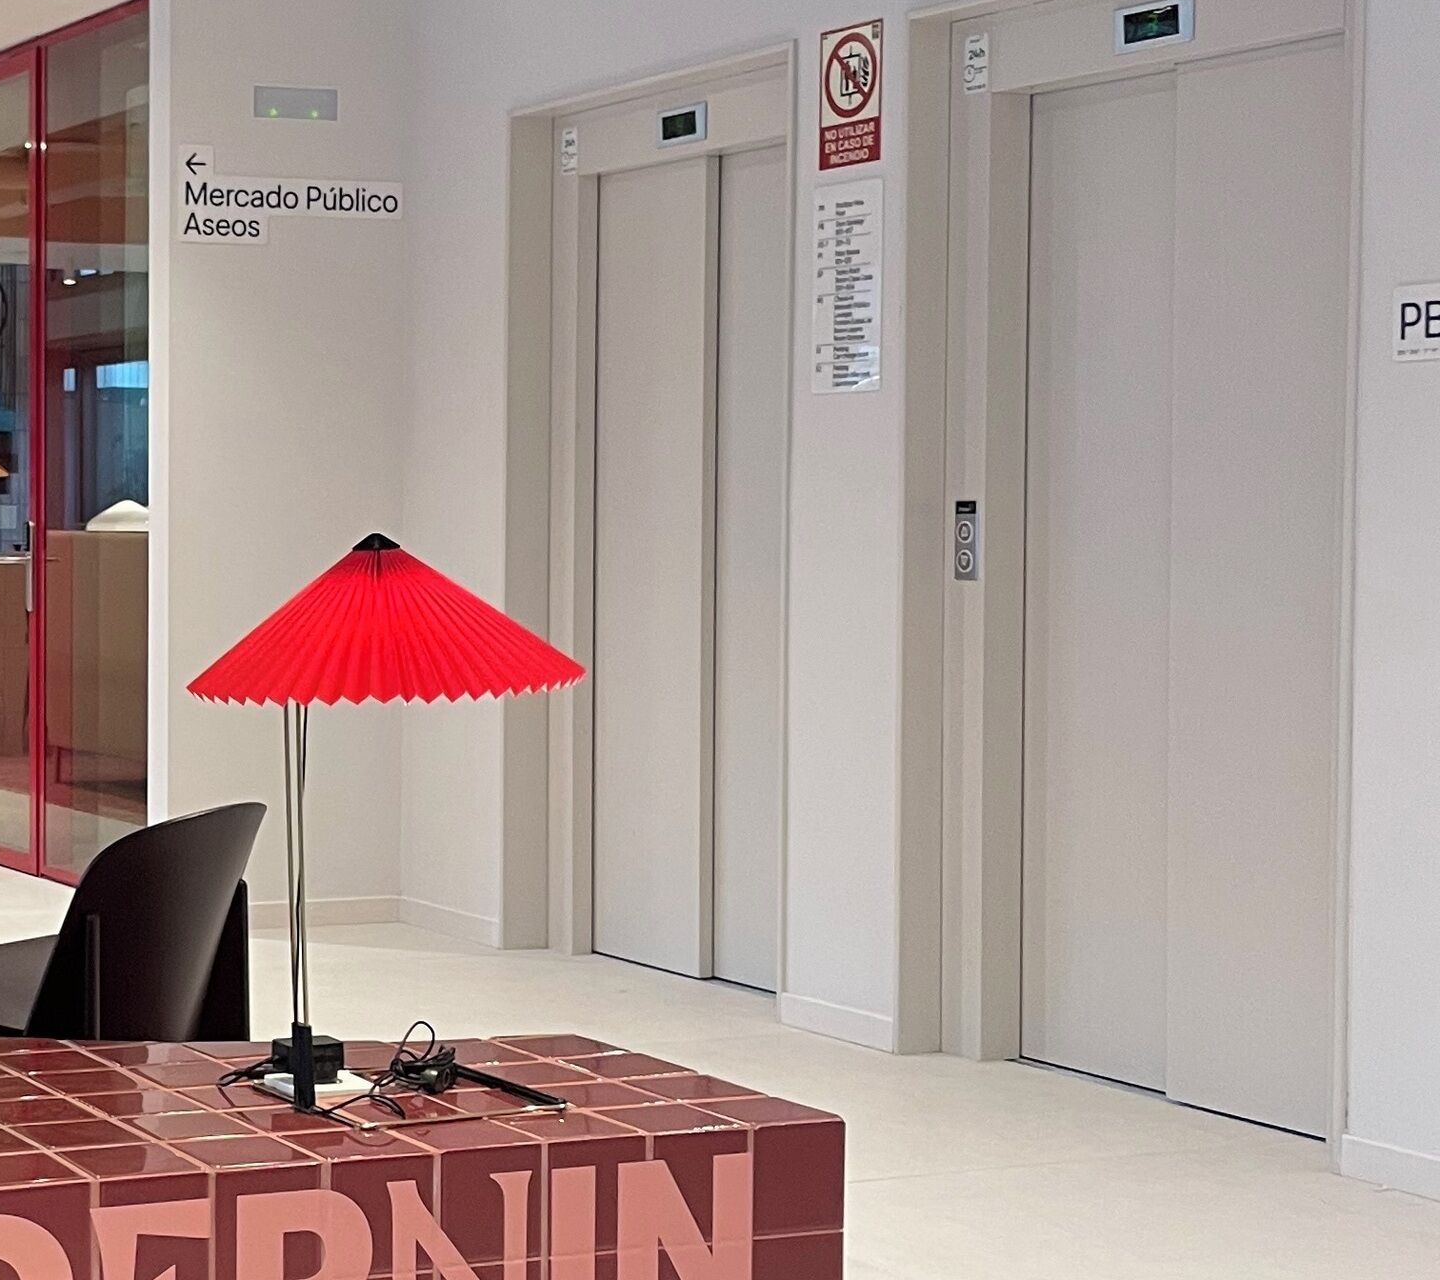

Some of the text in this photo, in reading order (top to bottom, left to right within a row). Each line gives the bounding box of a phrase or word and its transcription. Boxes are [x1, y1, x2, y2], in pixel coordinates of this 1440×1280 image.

[824, 122, 875, 140] NO UTILIZAR
[824, 134, 874, 153] EN CASO DE
[184, 181, 399, 213] Mercado Público
[183, 212, 261, 237] Aseos
[1400, 300, 1440, 340] PE
